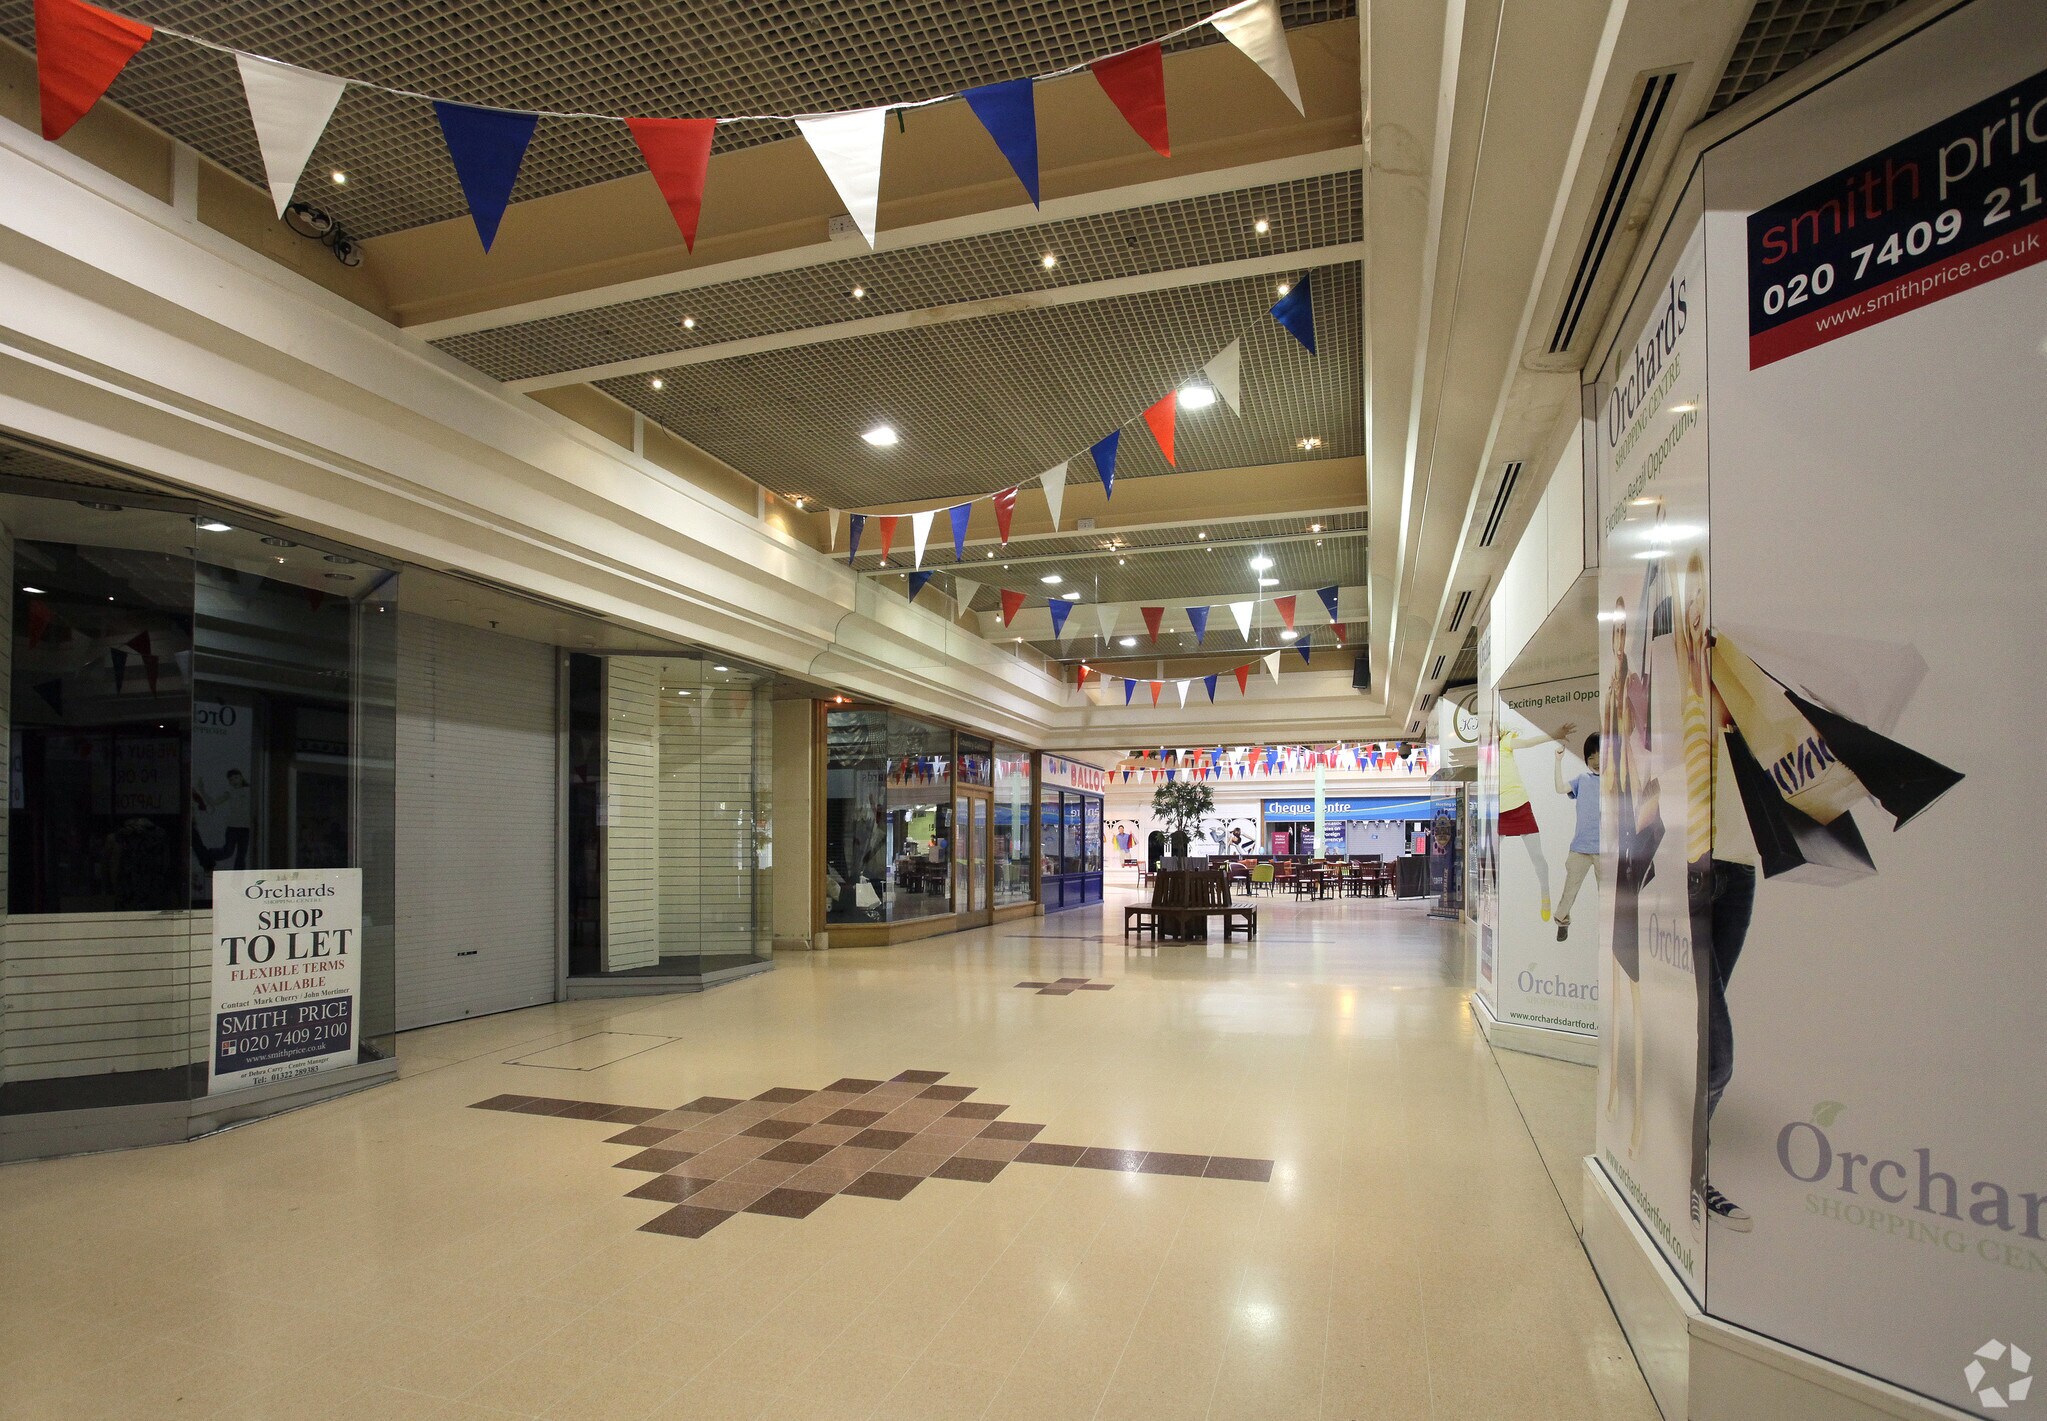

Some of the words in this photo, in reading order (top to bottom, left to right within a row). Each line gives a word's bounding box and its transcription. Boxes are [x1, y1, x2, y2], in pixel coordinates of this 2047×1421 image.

[1761, 158, 1920, 265] smith
[1763, 263, 1834, 316] 020
[1850, 208, 1962, 281] 7409
[1983, 172, 2043, 227] 21
[1815, 233, 2041, 332] www.smithprice.co.uk
[1609, 275, 1687, 447] Orchards
[1615, 415, 1649, 473] SHOPPING
[1648, 352, 1681, 420] CENTRE
[1605, 497, 1627, 539] Exciting
[1627, 461, 1647, 500] Retail
[1508, 698, 1543, 710] Exciting
[1545, 692, 1571, 704] Retail
[1269, 802, 1311, 816] Cheque
[1324, 802, 1351, 813] entre
[245, 883, 335, 899] Orchards
[258, 909, 324, 931] SHOP
[221, 935, 276, 966] TO
[286, 929, 353, 961] LET
[231, 965, 299, 982] FLEXIBLE
[303, 960, 345, 974] TERMS
[253, 977, 326, 995] AVAILABLE
[221, 1000, 250, 1010] Contact
[254, 996, 273, 1005] Mark
[275, 994, 298, 1003] Cherry
[304, 991, 320, 999] John
[321, 987, 350, 996] Mortimer
[222, 1009, 288, 1035] SMITH
[299, 1001, 348, 1023] PRICE
[239, 1034, 269, 1054] 020
[275, 1028, 310, 1048] 7409
[314, 1022, 347, 1041] 2100
[246, 1042, 326, 1064] www.smithprice.co.uk
[249, 1069, 267, 1077] Debra
[289, 1061, 307, 1070] Centre
[308, 1057, 329, 1066] Manager
[253, 1077, 267, 1085] Tel:
[271, 1071, 293, 1081] 01322
[1605, 1146, 1694, 1279] www.orchardsdartford.co.uk
[1805, 1193, 1968, 1254] SHOPPING
